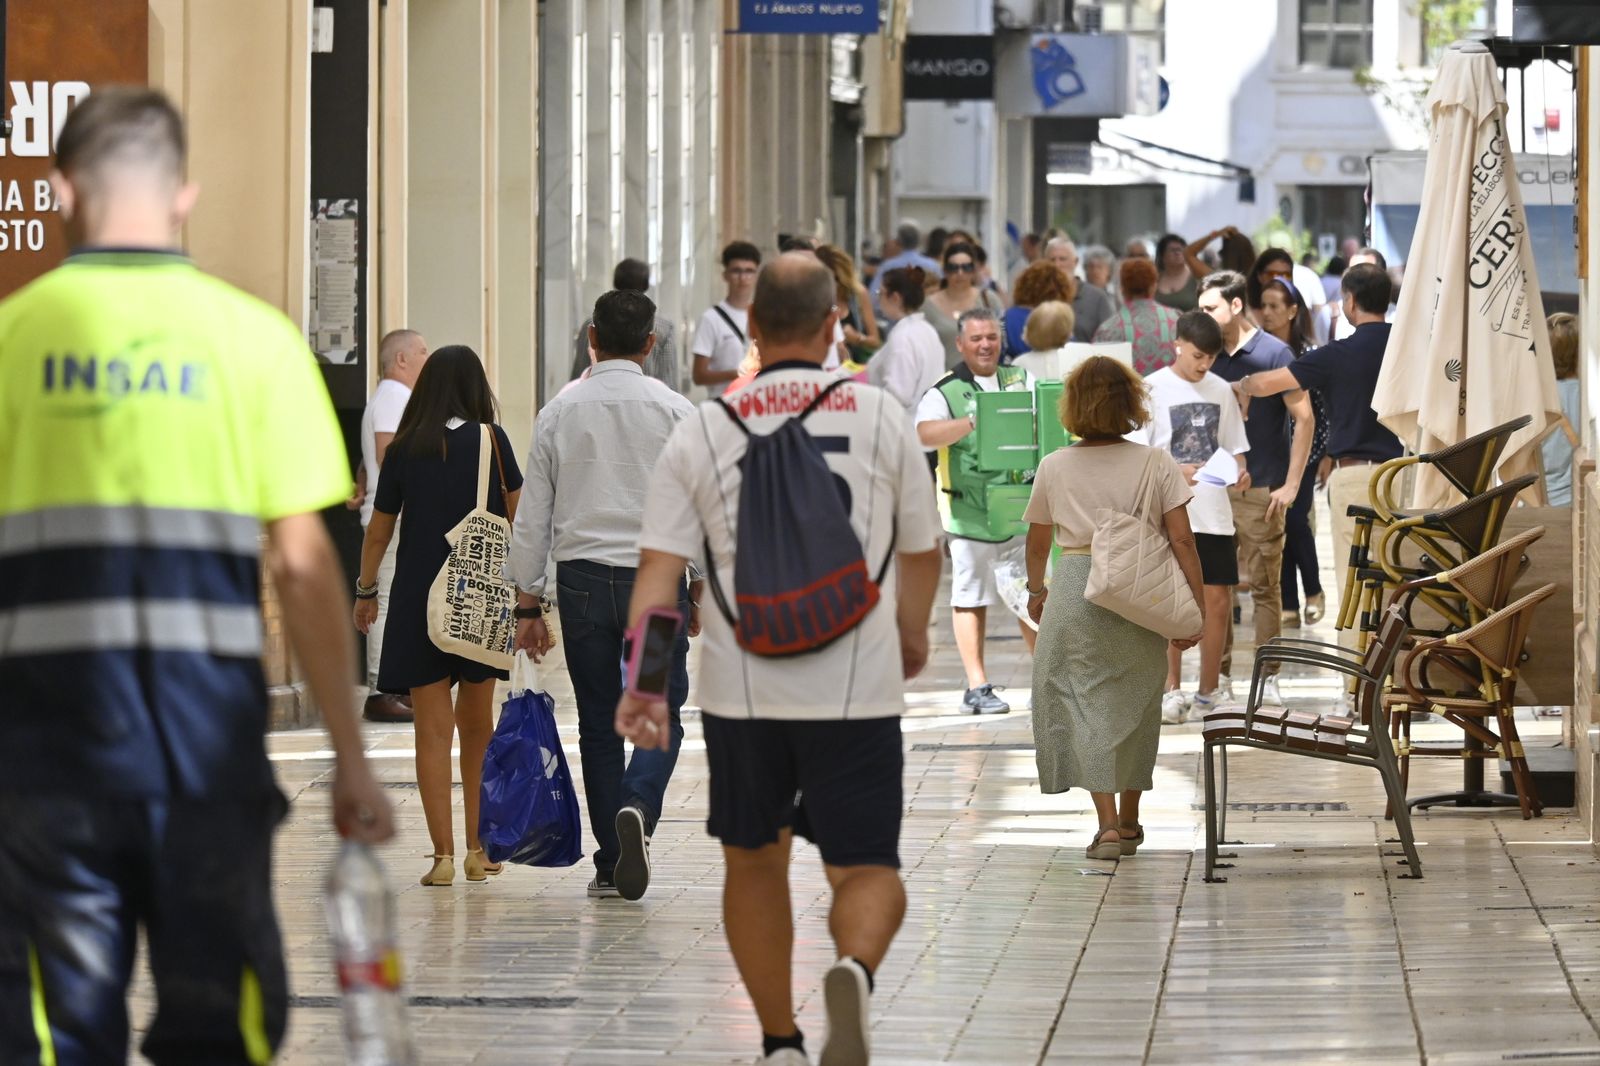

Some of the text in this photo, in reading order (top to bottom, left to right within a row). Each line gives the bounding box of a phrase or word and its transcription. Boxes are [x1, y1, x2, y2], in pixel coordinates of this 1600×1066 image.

[771, 2, 815, 14] ÁBALOS
[819, 4, 864, 15] NUEVO
[907, 58, 989, 76] MANGO
[479, 527, 504, 542] BOSTON
[468, 535, 485, 561] USA
[483, 541, 493, 576] BOSTON
[455, 568, 473, 578] USA
[446, 569, 456, 605] BOSTON
[485, 594, 501, 603] USA
[740, 571, 866, 645] PUMA
[470, 591, 484, 634] BOSTON
[484, 601, 495, 618] USA
[442, 612, 452, 633] USA
[462, 613, 471, 632] USA
[486, 619, 500, 651] BOSTON
